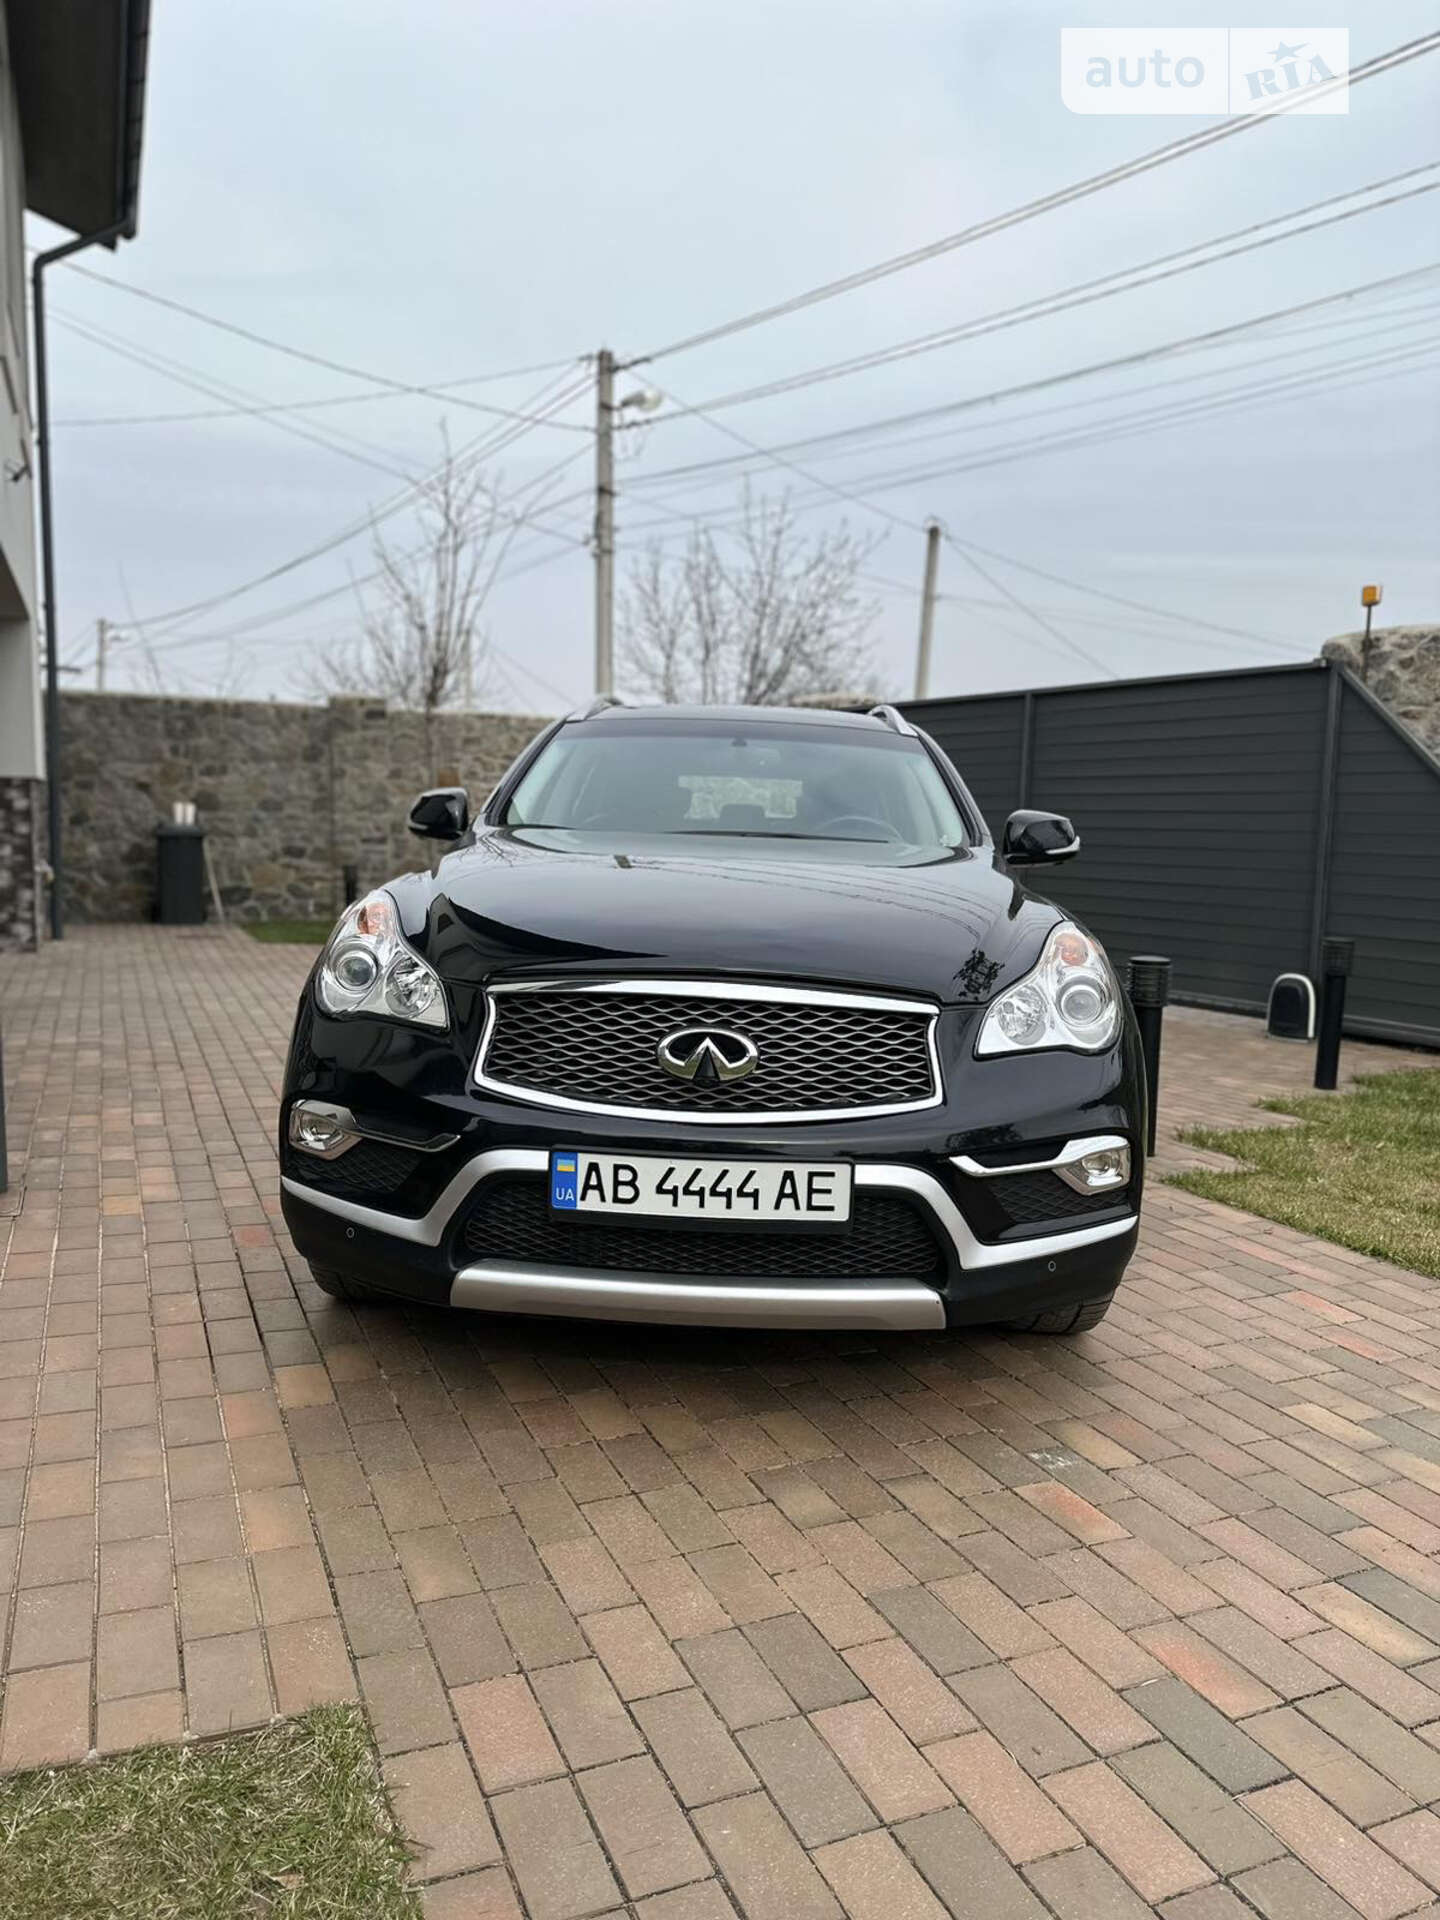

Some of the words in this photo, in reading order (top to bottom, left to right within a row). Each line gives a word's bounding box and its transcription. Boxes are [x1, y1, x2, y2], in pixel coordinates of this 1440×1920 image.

[555, 1187, 575, 1201] UA
[579, 1161, 640, 1204] AB
[655, 1167, 760, 1211] 4444
[773, 1170, 836, 1211] AE
